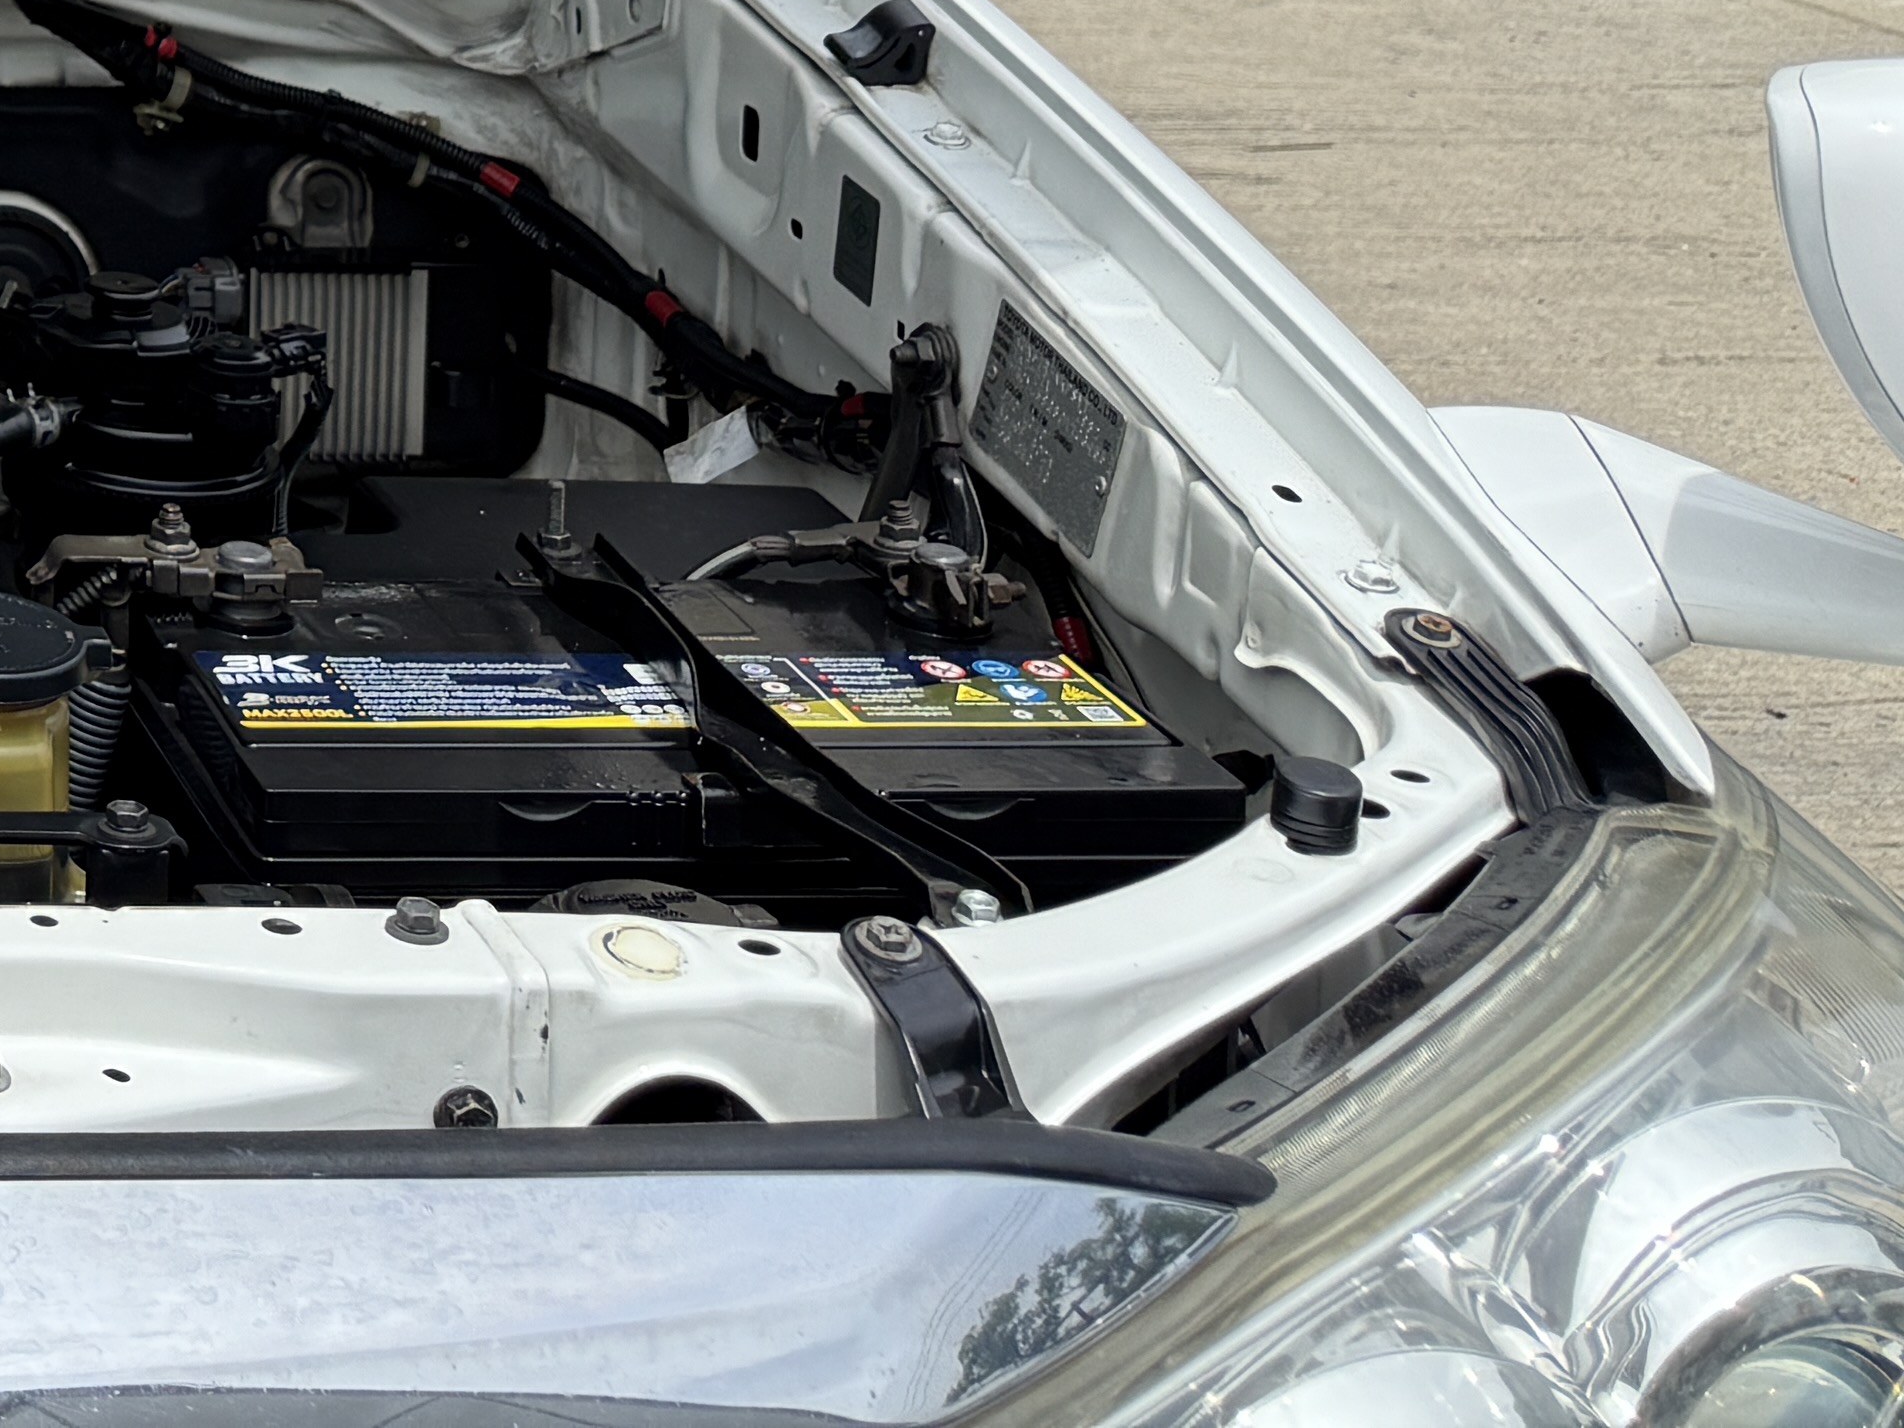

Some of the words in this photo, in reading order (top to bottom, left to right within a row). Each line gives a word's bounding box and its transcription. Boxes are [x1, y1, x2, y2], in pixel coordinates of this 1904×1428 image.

[1030, 332, 1054, 360] MOTOR
[213, 654, 311, 673] 3K
[216, 671, 324, 685] BATTERY
